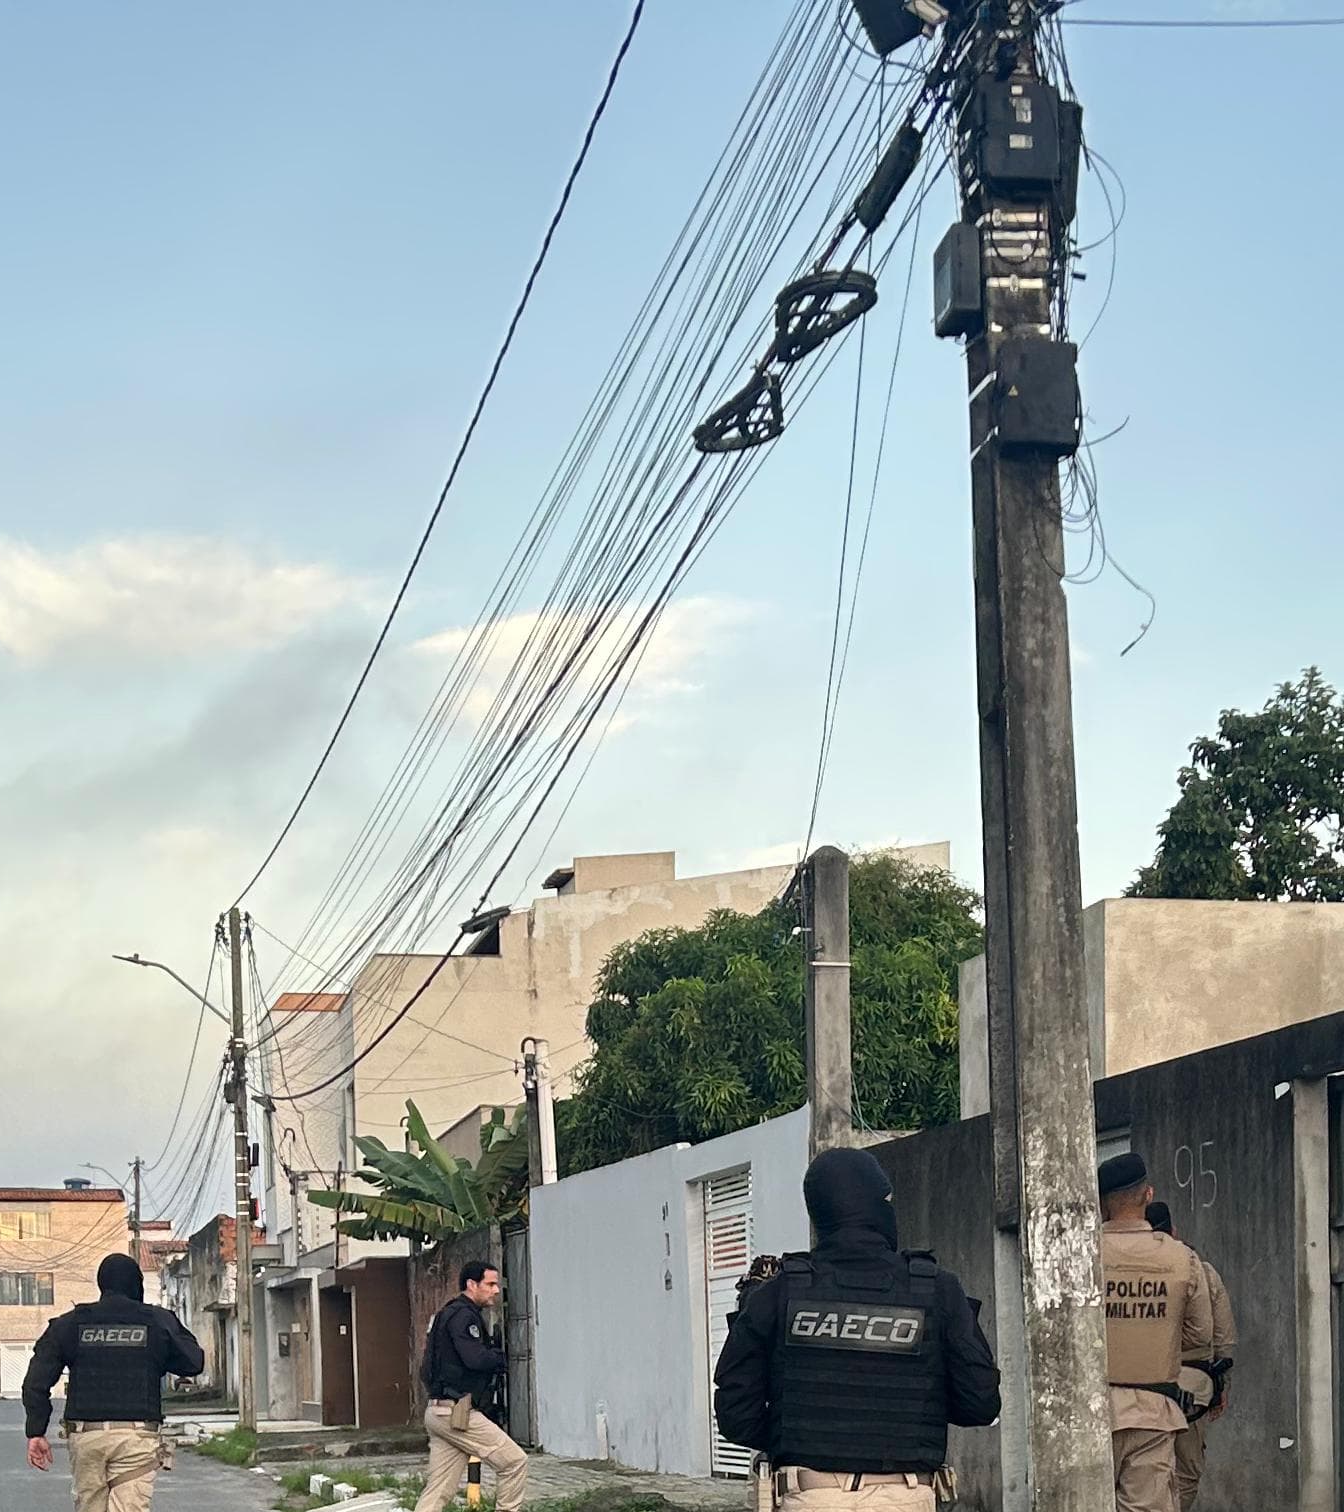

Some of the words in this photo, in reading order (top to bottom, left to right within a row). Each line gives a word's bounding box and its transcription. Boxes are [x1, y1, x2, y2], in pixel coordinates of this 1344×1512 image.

[1174, 1141, 1217, 1211] 95
[1106, 1276, 1168, 1297] POLÍCIA
[1105, 1302, 1166, 1318] MILITAR
[81, 1329, 145, 1342] GAECO
[791, 1311, 919, 1344] GAECO
